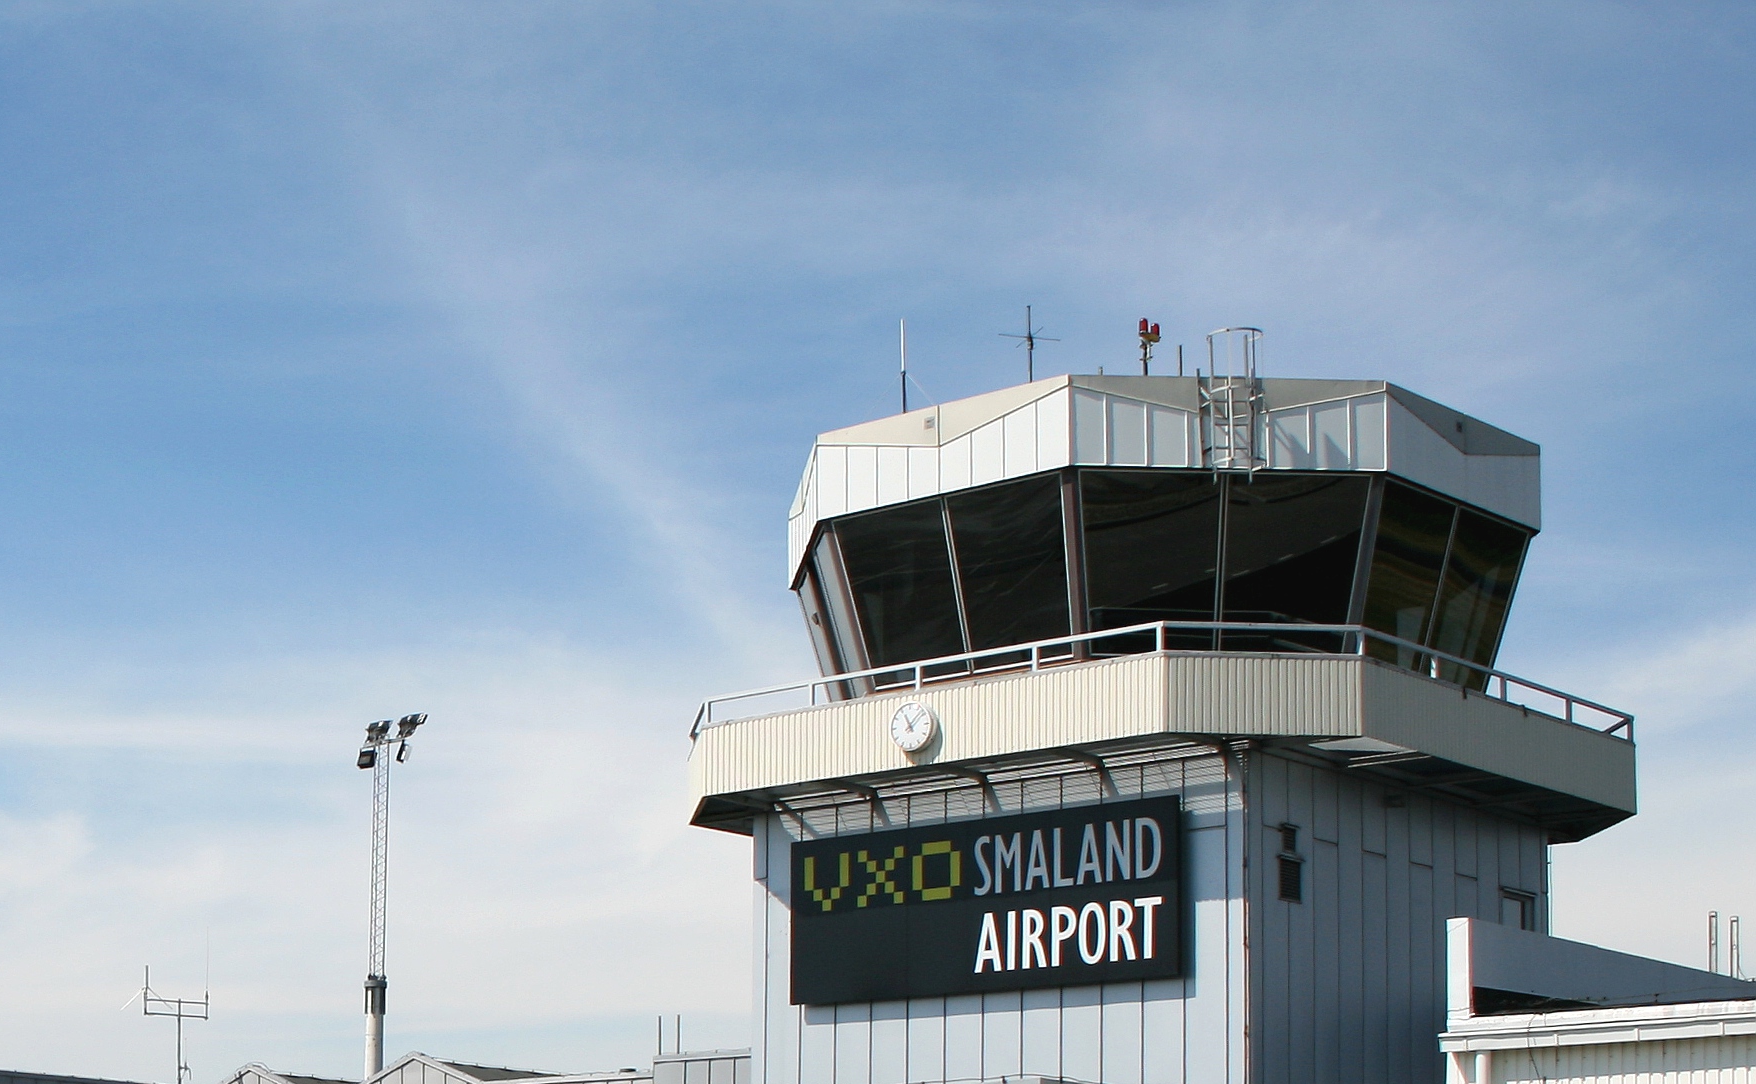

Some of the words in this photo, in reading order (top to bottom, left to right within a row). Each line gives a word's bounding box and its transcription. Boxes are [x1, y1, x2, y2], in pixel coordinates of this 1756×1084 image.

[803, 839, 961, 912] VXO
[973, 816, 1163, 896] SMALAND
[973, 896, 1163, 974] AIRPORT
